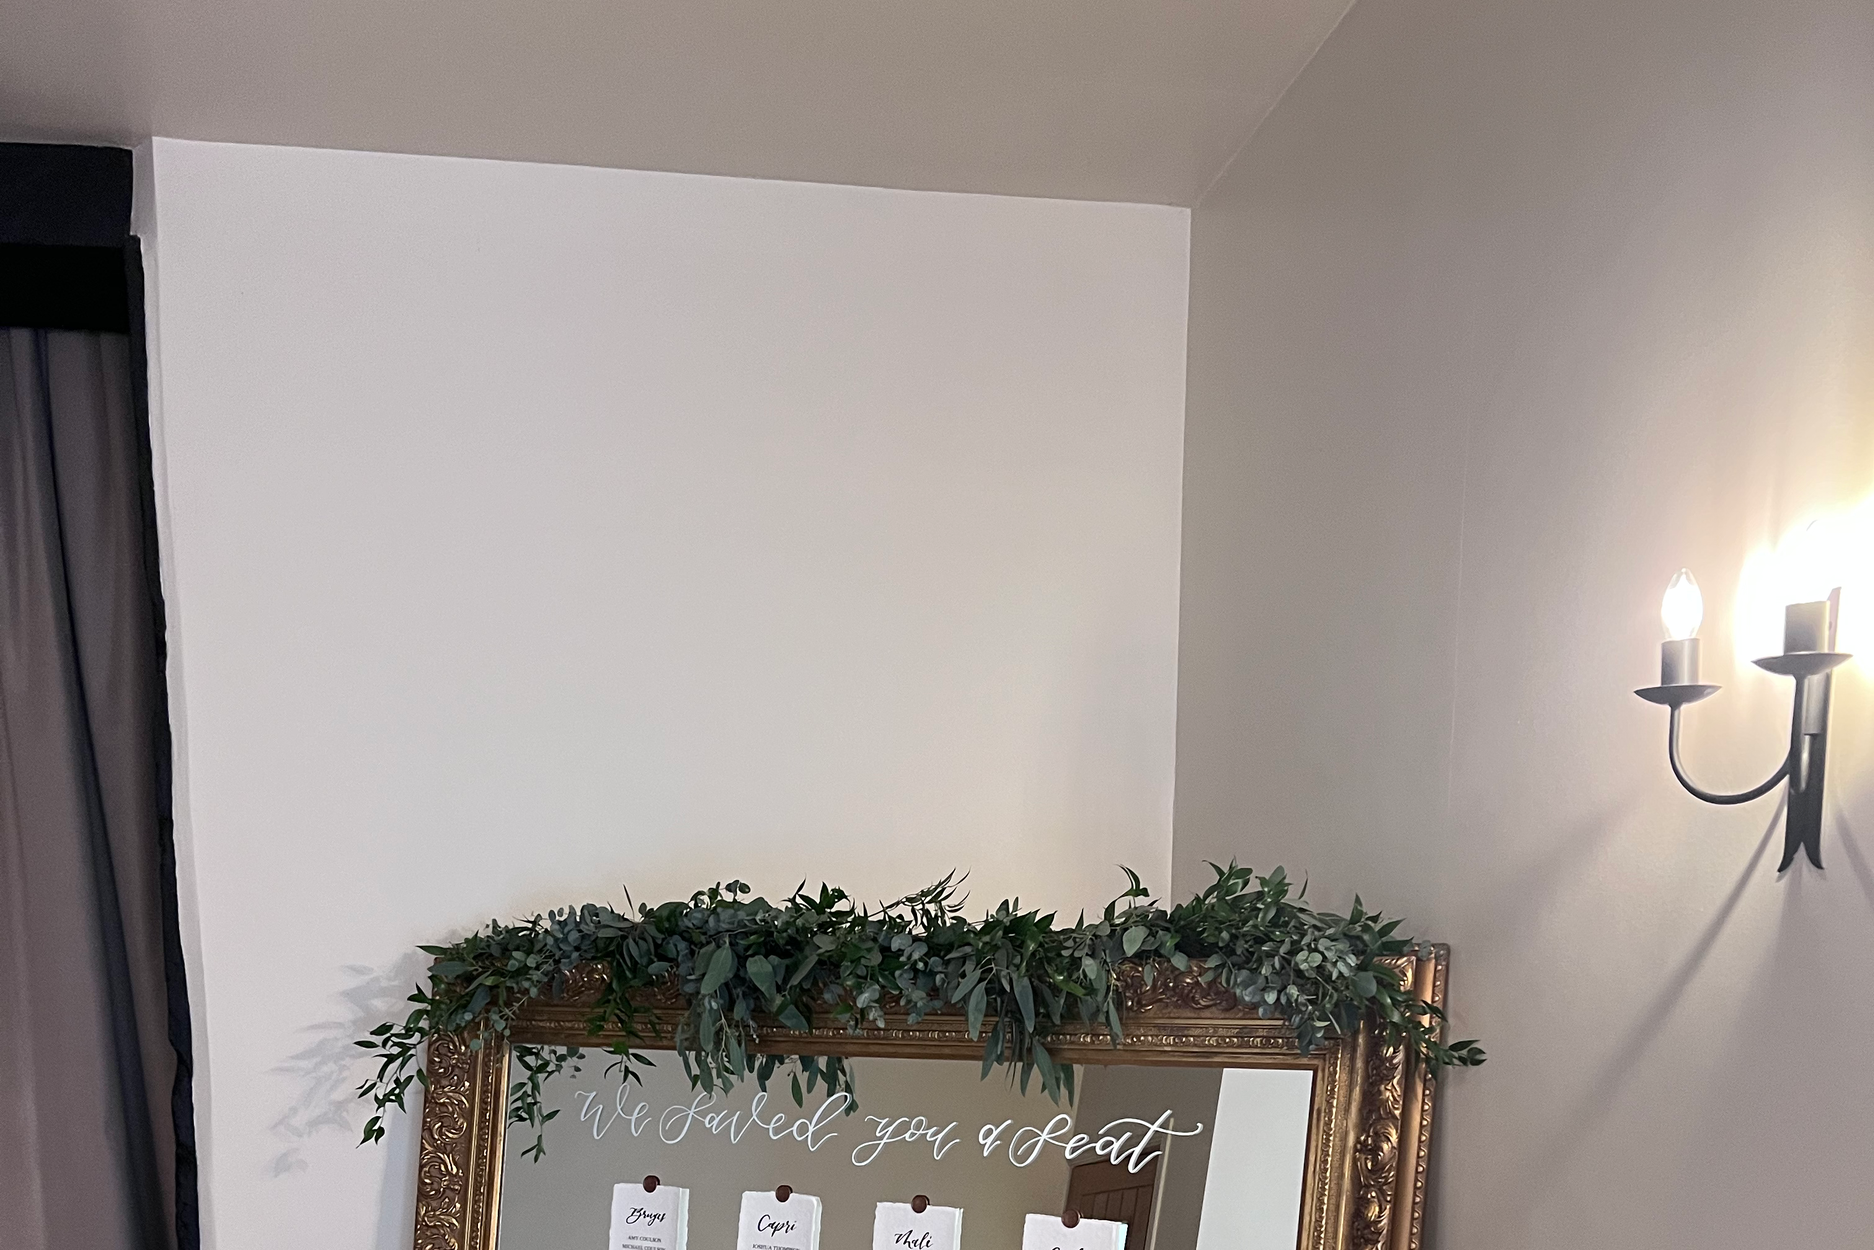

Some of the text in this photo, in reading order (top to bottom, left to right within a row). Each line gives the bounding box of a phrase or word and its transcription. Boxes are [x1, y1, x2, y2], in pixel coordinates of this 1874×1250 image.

[850, 1115, 961, 1167] you
[977, 1119, 1014, 1157] a
[626, 1207, 666, 1226] Bruges
[757, 1214, 797, 1237] Capri
[894, 1229, 933, 1250] Mali
